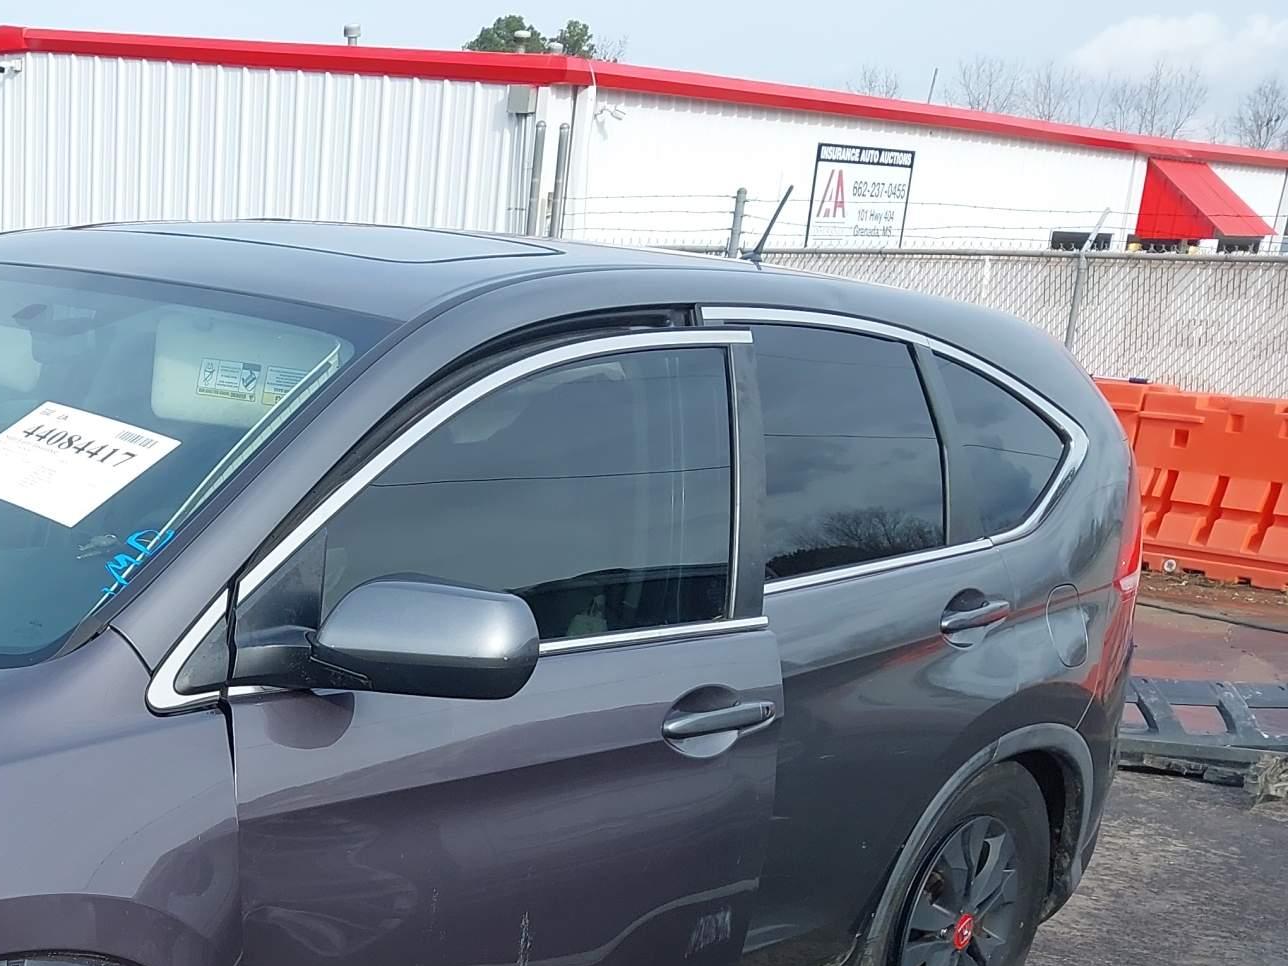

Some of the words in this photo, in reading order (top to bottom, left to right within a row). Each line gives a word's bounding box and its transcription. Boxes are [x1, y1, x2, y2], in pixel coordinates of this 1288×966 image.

[820, 145, 860, 162] INSURANCE
[860, 149, 880, 163] AUTO
[879, 150, 912, 165] AUCTIONS
[852, 180, 907, 199] 662-237-0455
[857, 209, 867, 221] 101
[22, 424, 139, 467] 44084417
